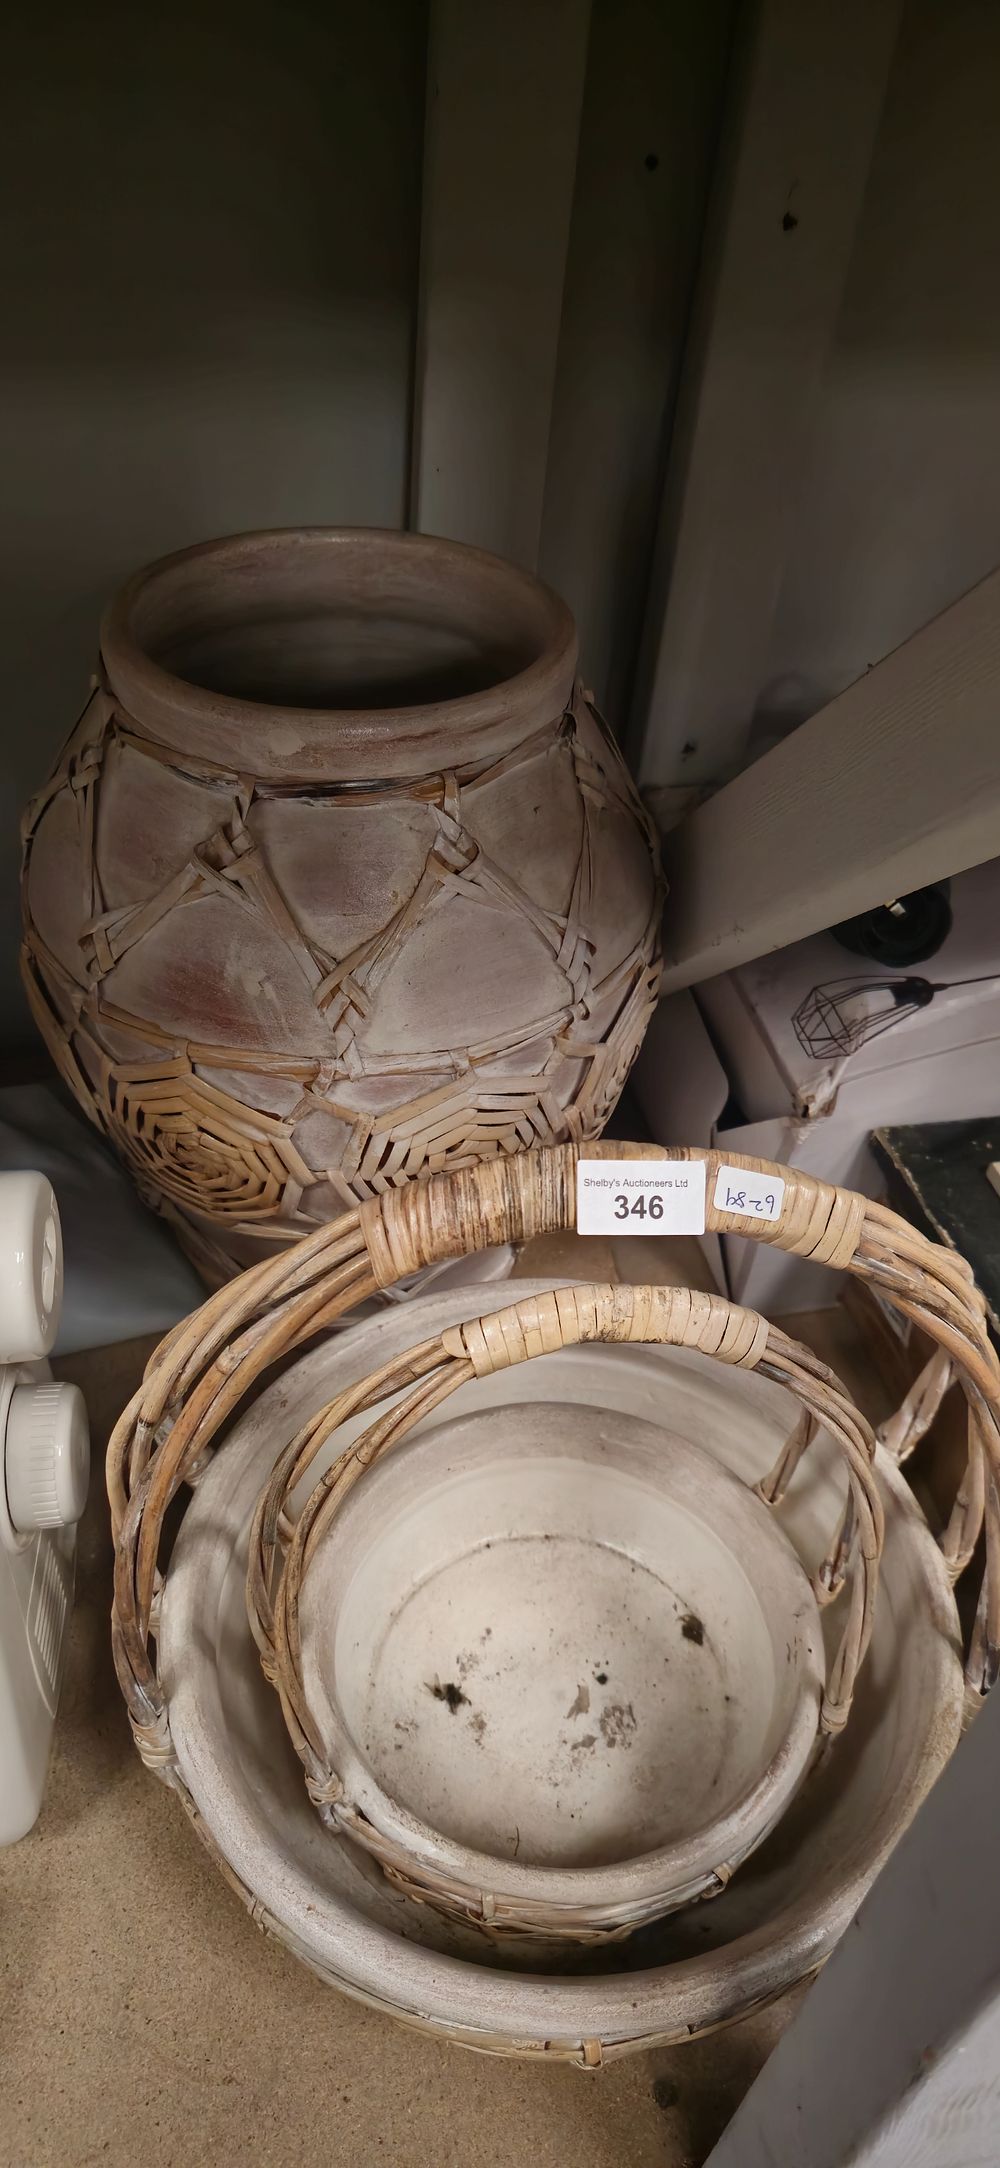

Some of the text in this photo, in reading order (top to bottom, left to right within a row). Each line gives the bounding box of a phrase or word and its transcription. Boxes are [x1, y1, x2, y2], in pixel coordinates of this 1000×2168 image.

[584, 1178, 689, 1189] Shelby's Auctioneers Ltd
[614, 1194, 664, 1220] 346
